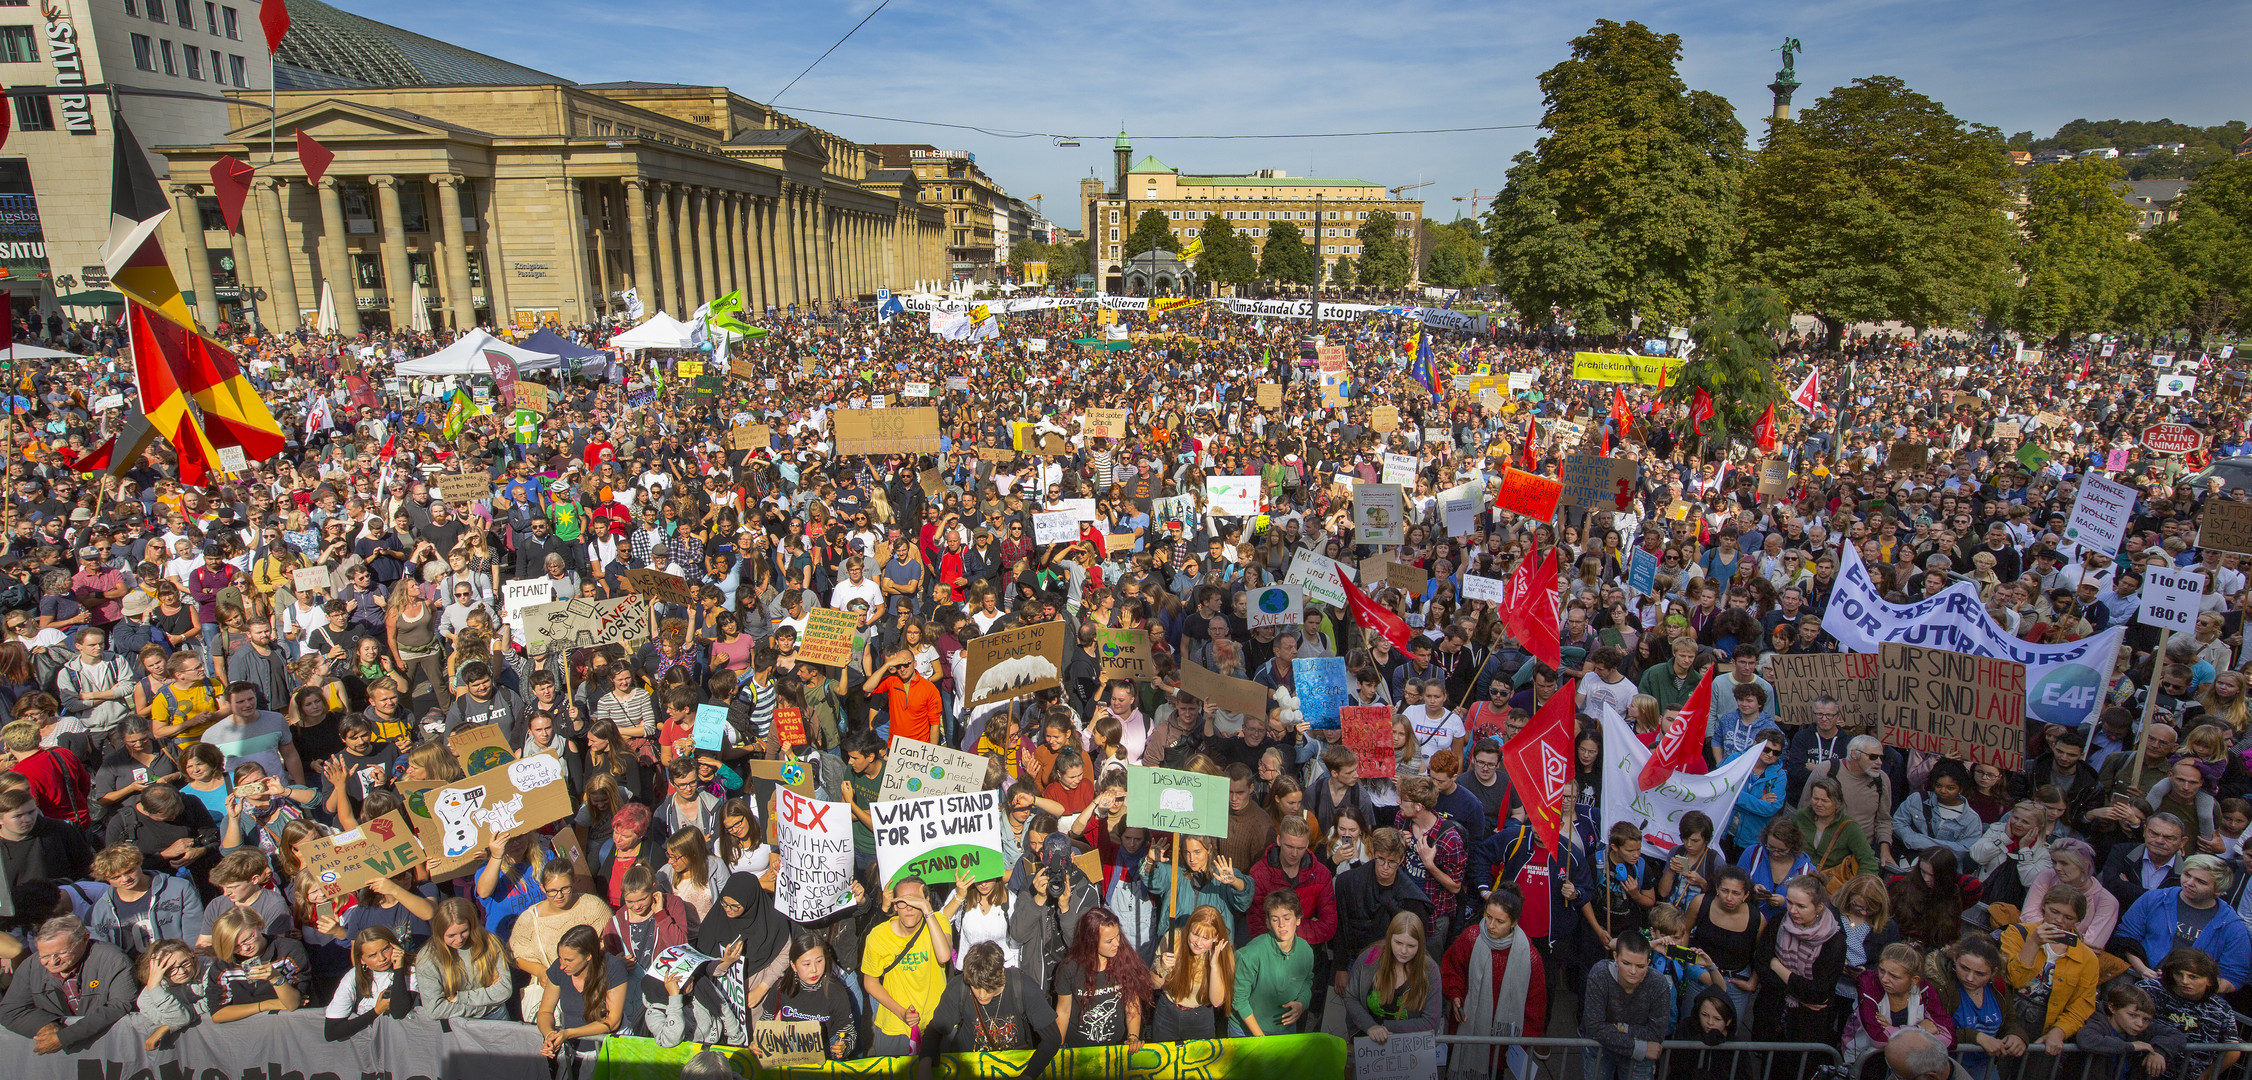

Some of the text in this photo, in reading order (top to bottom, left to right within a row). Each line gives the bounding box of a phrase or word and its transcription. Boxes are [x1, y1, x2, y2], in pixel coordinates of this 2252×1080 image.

[44, 21, 92, 131] SATURN
[1644, 364, 1658, 373] für
[870, 415, 905, 432] ÖKO
[2160, 425, 2187, 434] STOP
[2147, 440, 2193, 451] ANIMALS
[2149, 433, 2195, 443] EATING
[1567, 455, 1614, 468] DIE DINOS
[1566, 465, 1609, 478] DACHTEN
[1564, 477, 1609, 490] AUCH SIE
[2075, 515, 2115, 541] MACHEN!
[2209, 518, 2229, 530] IST
[1297, 550, 1311, 562] Mit
[1306, 566, 1324, 580] und
[2159, 576, 2174, 588] to
[509, 583, 549, 598] PFLANZT
[623, 594, 637, 606] TO
[1303, 577, 1346, 605] Klimaschutz
[1251, 612, 1299, 628] SAVE ME
[2149, 605, 2174, 620] 180
[599, 609, 634, 645] WORK
[622, 616, 647, 640] OUT!
[1826, 588, 1996, 659] FOR FUTURE
[979, 627, 1045, 650] THERE IS NO
[1098, 631, 1145, 645] PLANET
[987, 642, 1034, 661] PLANET
[1101, 656, 1145, 670] PROFIT
[1299, 659, 1338, 673] Like the
[1771, 656, 1842, 680] MACHT IHR
[1882, 645, 2026, 692] WIR SIND HIER
[1301, 681, 1345, 698] Oceans
[2041, 683, 2097, 709] E4F
[1882, 673, 2025, 727] WIR SIND LAUT
[1343, 707, 1390, 721] WAKE UP
[450, 726, 498, 748] RETTET
[1881, 702, 1919, 731] WEIL
[1921, 706, 1956, 738] IHR
[1962, 719, 2003, 749] UNS
[2002, 728, 2025, 753] DIE
[899, 745, 974, 770] can't do all the
[1881, 726, 2024, 771] ZUKUNFT KLAUT!
[516, 761, 542, 774] Oma
[896, 756, 928, 774] good
[516, 769, 550, 784] was ist
[884, 773, 968, 794] But ALL
[1151, 771, 1203, 788] DAS WAR'S
[465, 789, 485, 800] HELP
[782, 789, 832, 834] SEX
[874, 792, 994, 826] WHAT STAND
[876, 813, 984, 847] FOR IS WHAT
[1151, 811, 1201, 830] MIT LARS
[778, 822, 852, 854] NOW HAVE
[333, 840, 368, 856] Rising
[779, 840, 831, 871] GOT YOUR
[310, 852, 328, 865] ARE
[319, 858, 342, 873] AND
[343, 841, 420, 877] ARE WE
[907, 850, 981, 878] STAND ON
[785, 863, 847, 885] ATTENTION
[323, 881, 340, 890] FCK
[328, 886, 342, 897] AFD
[779, 871, 802, 897] STOP
[778, 886, 826, 911] WITH OUR
[788, 902, 836, 921] PLANET
[656, 947, 686, 973] SAVE
[1357, 1034, 1436, 1059] Ohne ERDE
[1359, 1054, 1418, 1076] ist GELD
